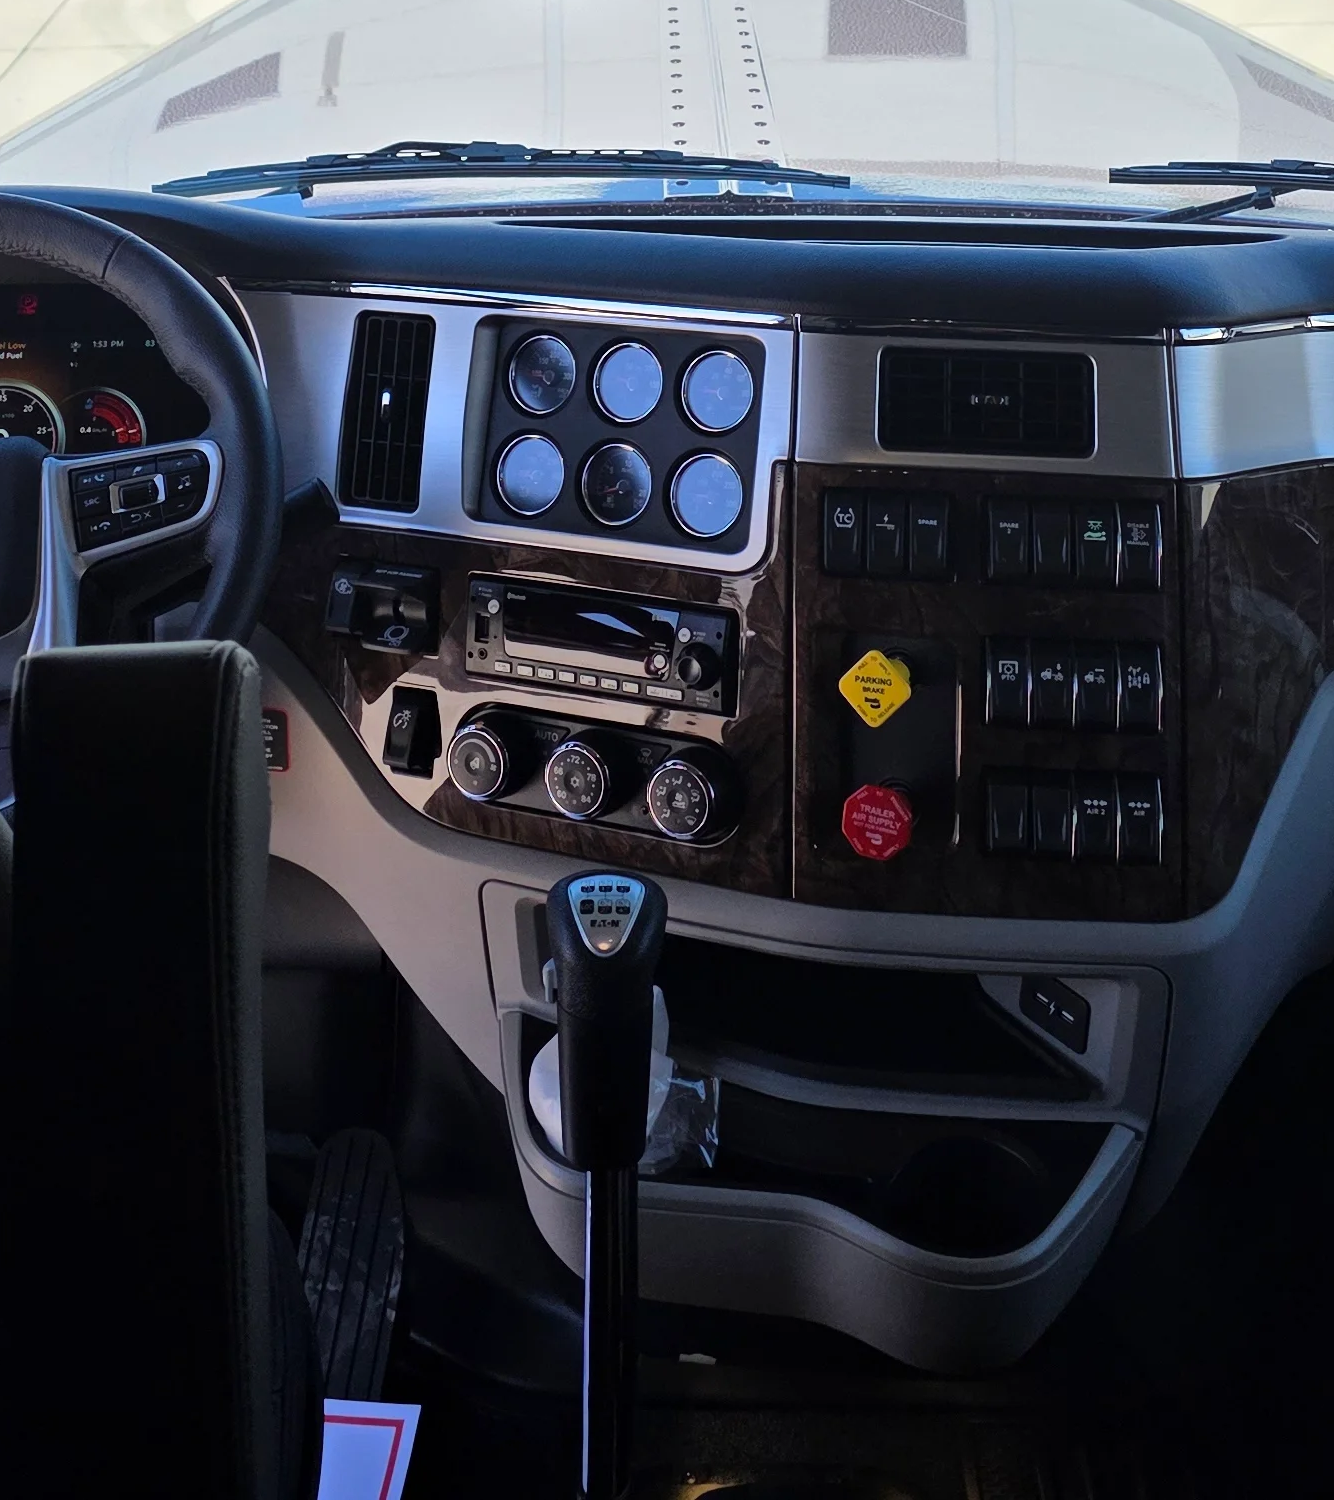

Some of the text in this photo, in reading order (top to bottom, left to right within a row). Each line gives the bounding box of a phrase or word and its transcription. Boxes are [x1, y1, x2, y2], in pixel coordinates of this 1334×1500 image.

[8, 342, 26, 350] Low
[93, 340, 124, 348] 1:53 PM
[6, 352, 23, 360] Fuel
[23, 405, 34, 413] 20
[36, 426, 47, 435] 25
[79, 426, 92, 434] 0.4
[83, 496, 101, 507] SRC
[837, 513, 852, 524] TC
[917, 518, 938, 526] SPARE
[999, 521, 1019, 529] SPARE
[854, 674, 892, 687] PARKING
[1000, 673, 1016, 681] PTO
[862, 686, 885, 695] BRAKE
[534, 730, 559, 742] AUTO
[570, 754, 581, 764] 72
[637, 756, 654, 766] MAX
[553, 766, 564, 776] 66
[586, 772, 597, 783] 78
[556, 789, 567, 799] 60
[580, 794, 592, 804] 84
[860, 803, 896, 820] TRAILER
[1086, 807, 1106, 816] AIR 2
[851, 811, 902, 830] AIR SUPPLY
